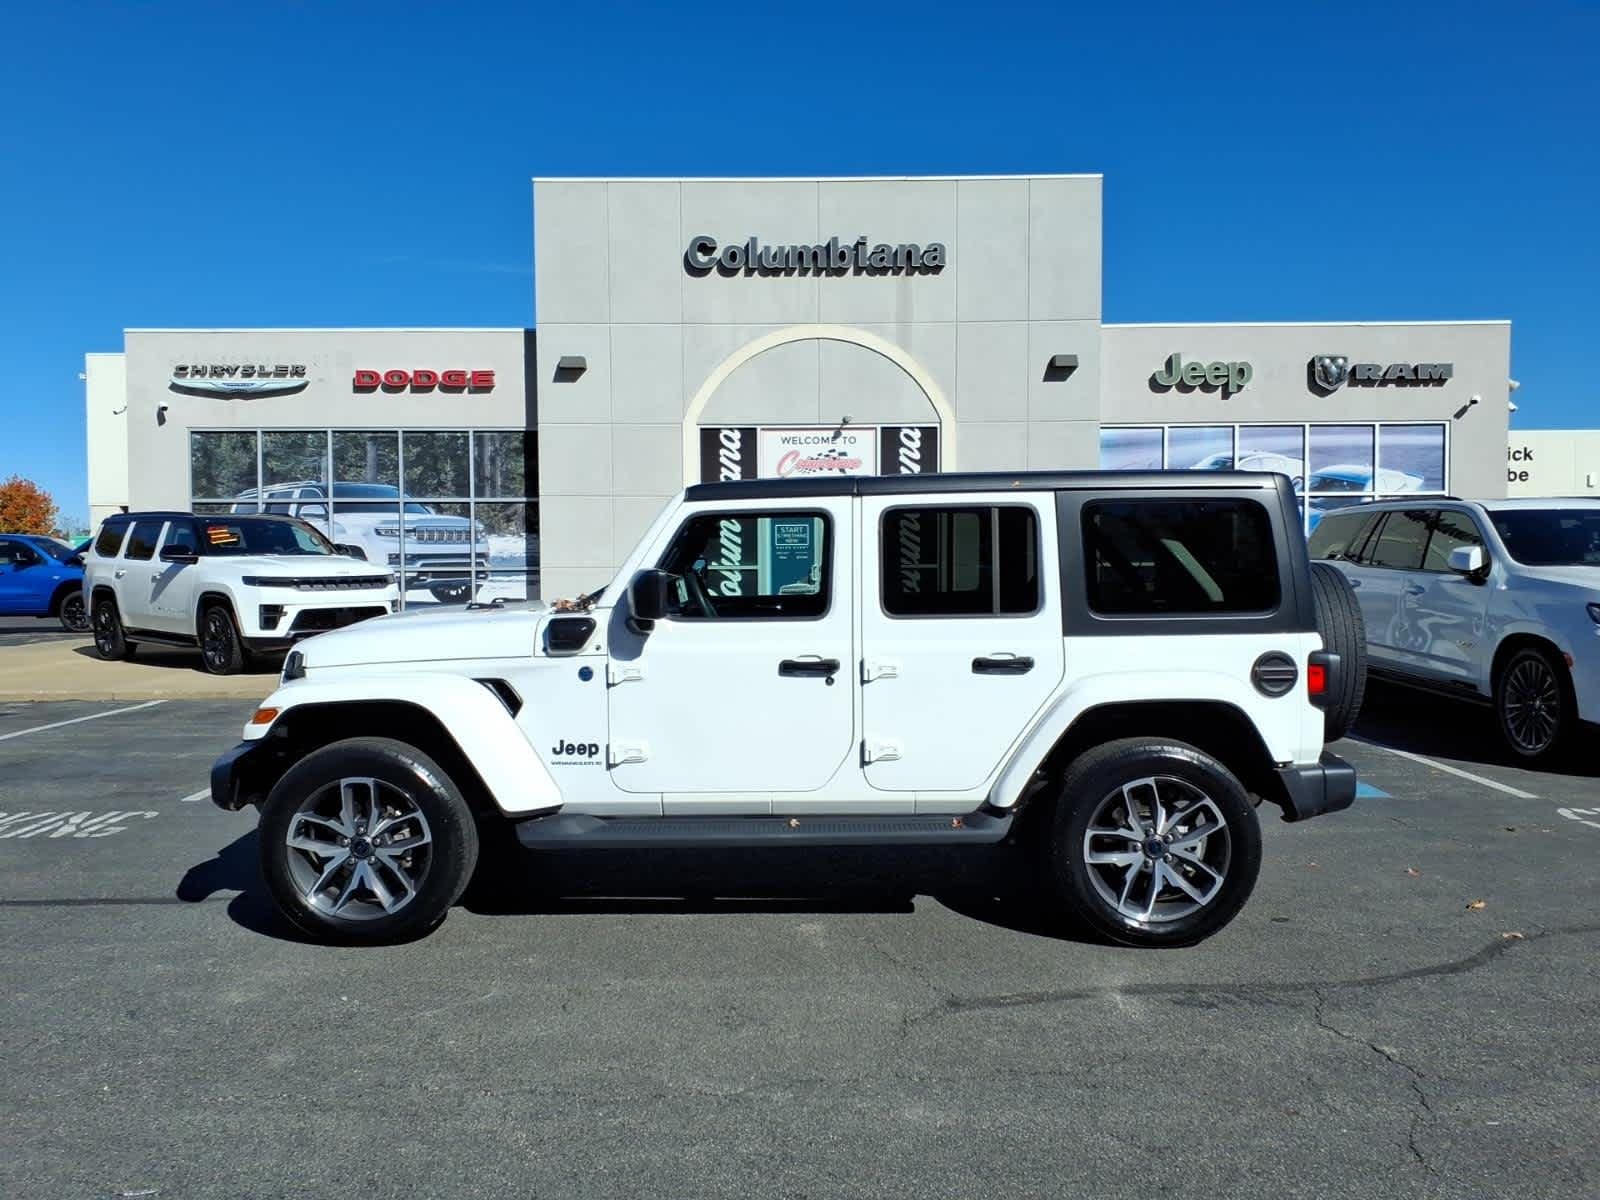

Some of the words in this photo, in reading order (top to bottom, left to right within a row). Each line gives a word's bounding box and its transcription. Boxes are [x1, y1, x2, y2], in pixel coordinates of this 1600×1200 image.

[687, 236, 946, 269] Columbiana
[174, 364, 306, 378] CHRYSLER
[355, 370, 495, 387] DODGE
[1157, 353, 1252, 393] Jeep
[1355, 363, 1453, 380] RAM
[781, 435, 836, 445] WELCOME
[843, 435, 857, 445] TO
[552, 739, 600, 758] Jeep
